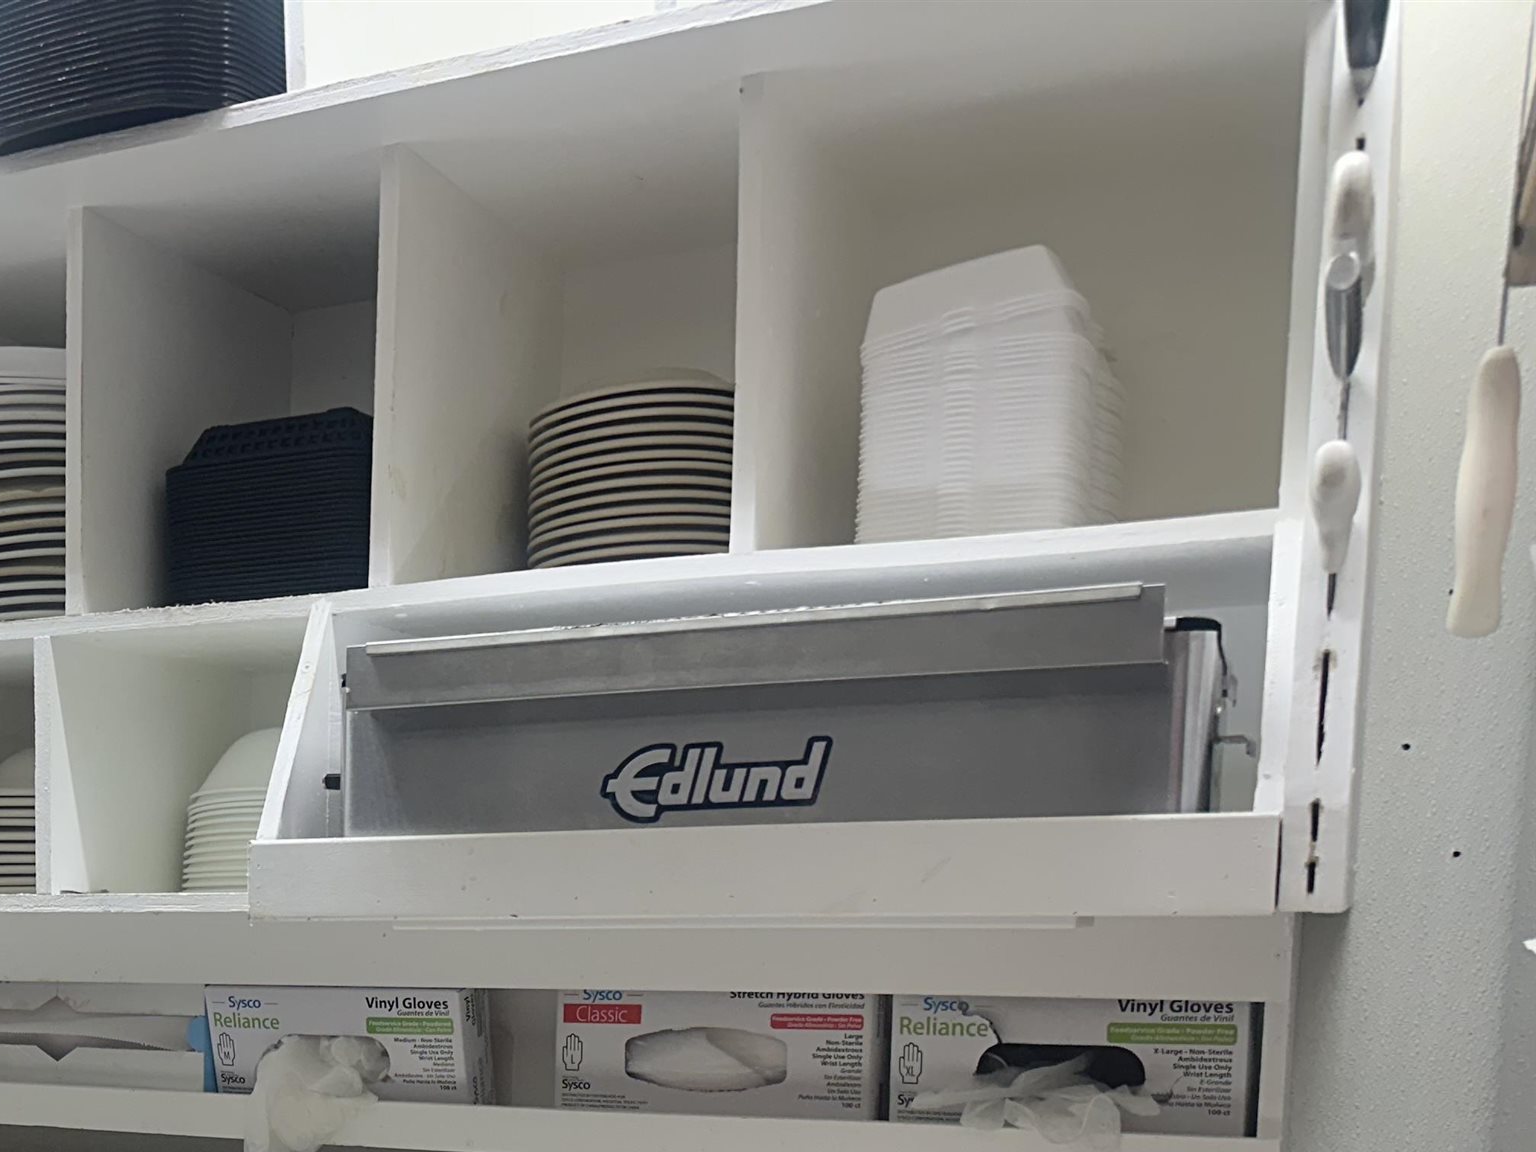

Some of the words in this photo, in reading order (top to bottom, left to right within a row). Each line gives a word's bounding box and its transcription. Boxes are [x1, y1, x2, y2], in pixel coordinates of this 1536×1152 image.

[601, 736, 832, 822] Edlund
[228, 996, 261, 1010] Sysco
[582, 990, 622, 1002] Sysco
[366, 996, 399, 1012] Vinyl
[402, 996, 448, 1010] Gloves
[924, 996, 969, 1014] Sysco
[1118, 1000, 1164, 1016] Vinyl
[1169, 1000, 1234, 1014] Gloves
[576, 1005, 628, 1022] Classic
[1160, 1014, 1198, 1022] Guantes
[1200, 1014, 1211, 1022] de
[213, 1012, 280, 1030] Reliance
[899, 1016, 988, 1037] Reliance
[224, 1051, 231, 1060] M
[571, 1054, 576, 1064] L
[905, 1066, 915, 1077] XL
[220, 1073, 246, 1085] Sysco
[562, 1078, 591, 1091] Sysco
